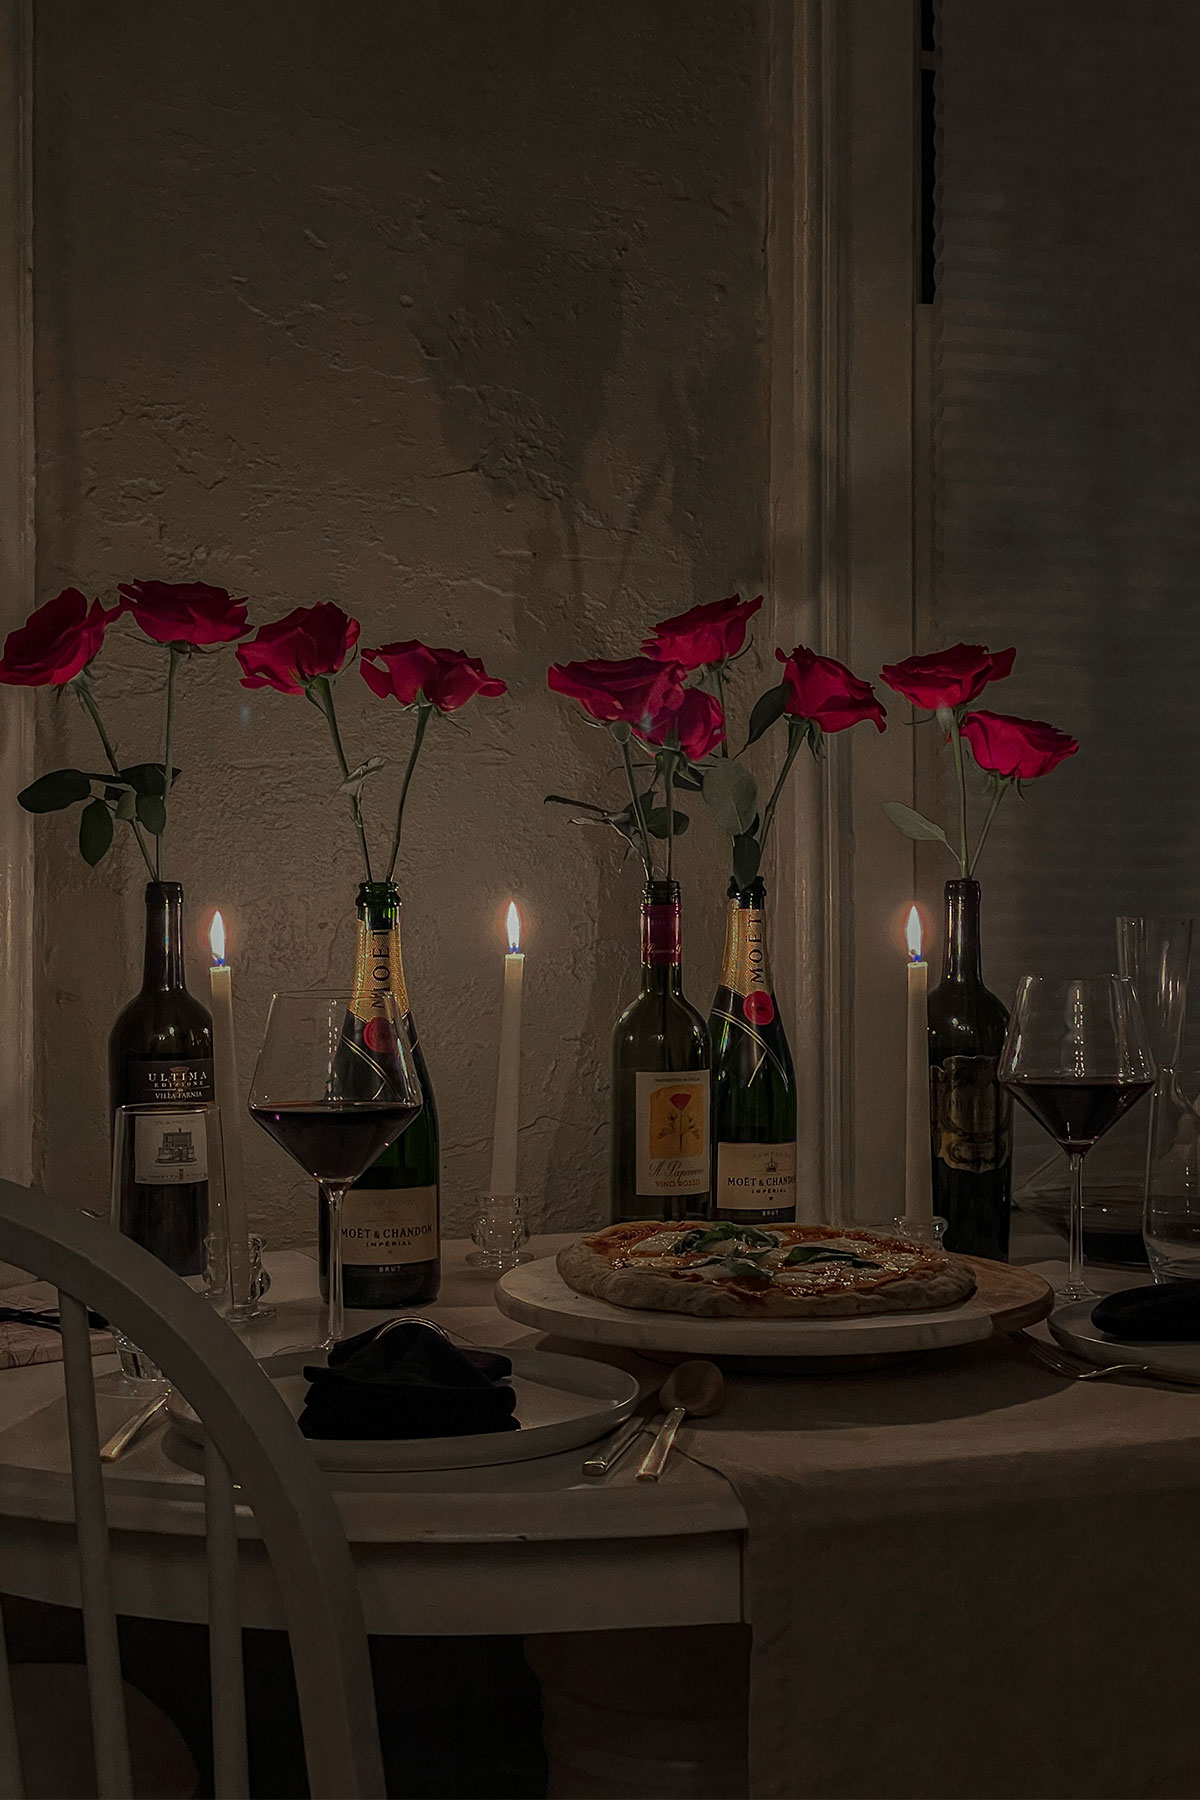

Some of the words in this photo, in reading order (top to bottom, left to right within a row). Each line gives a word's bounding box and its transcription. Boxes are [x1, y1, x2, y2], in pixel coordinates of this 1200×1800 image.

[745, 914, 764, 984] MOËT
[148, 1071, 207, 1082] ULTIMA
[154, 1092, 177, 1100] VILLA
[655, 1180, 676, 1188] VINO
[727, 1177, 757, 1187] MOËT
[758, 1179, 764, 1187] &
[766, 1175, 796, 1186] CHAND
[341, 1227, 371, 1239] MOËT
[373, 1230, 380, 1239] &
[383, 1223, 433, 1239] CHANDON
[378, 1265, 401, 1273] BRUT
